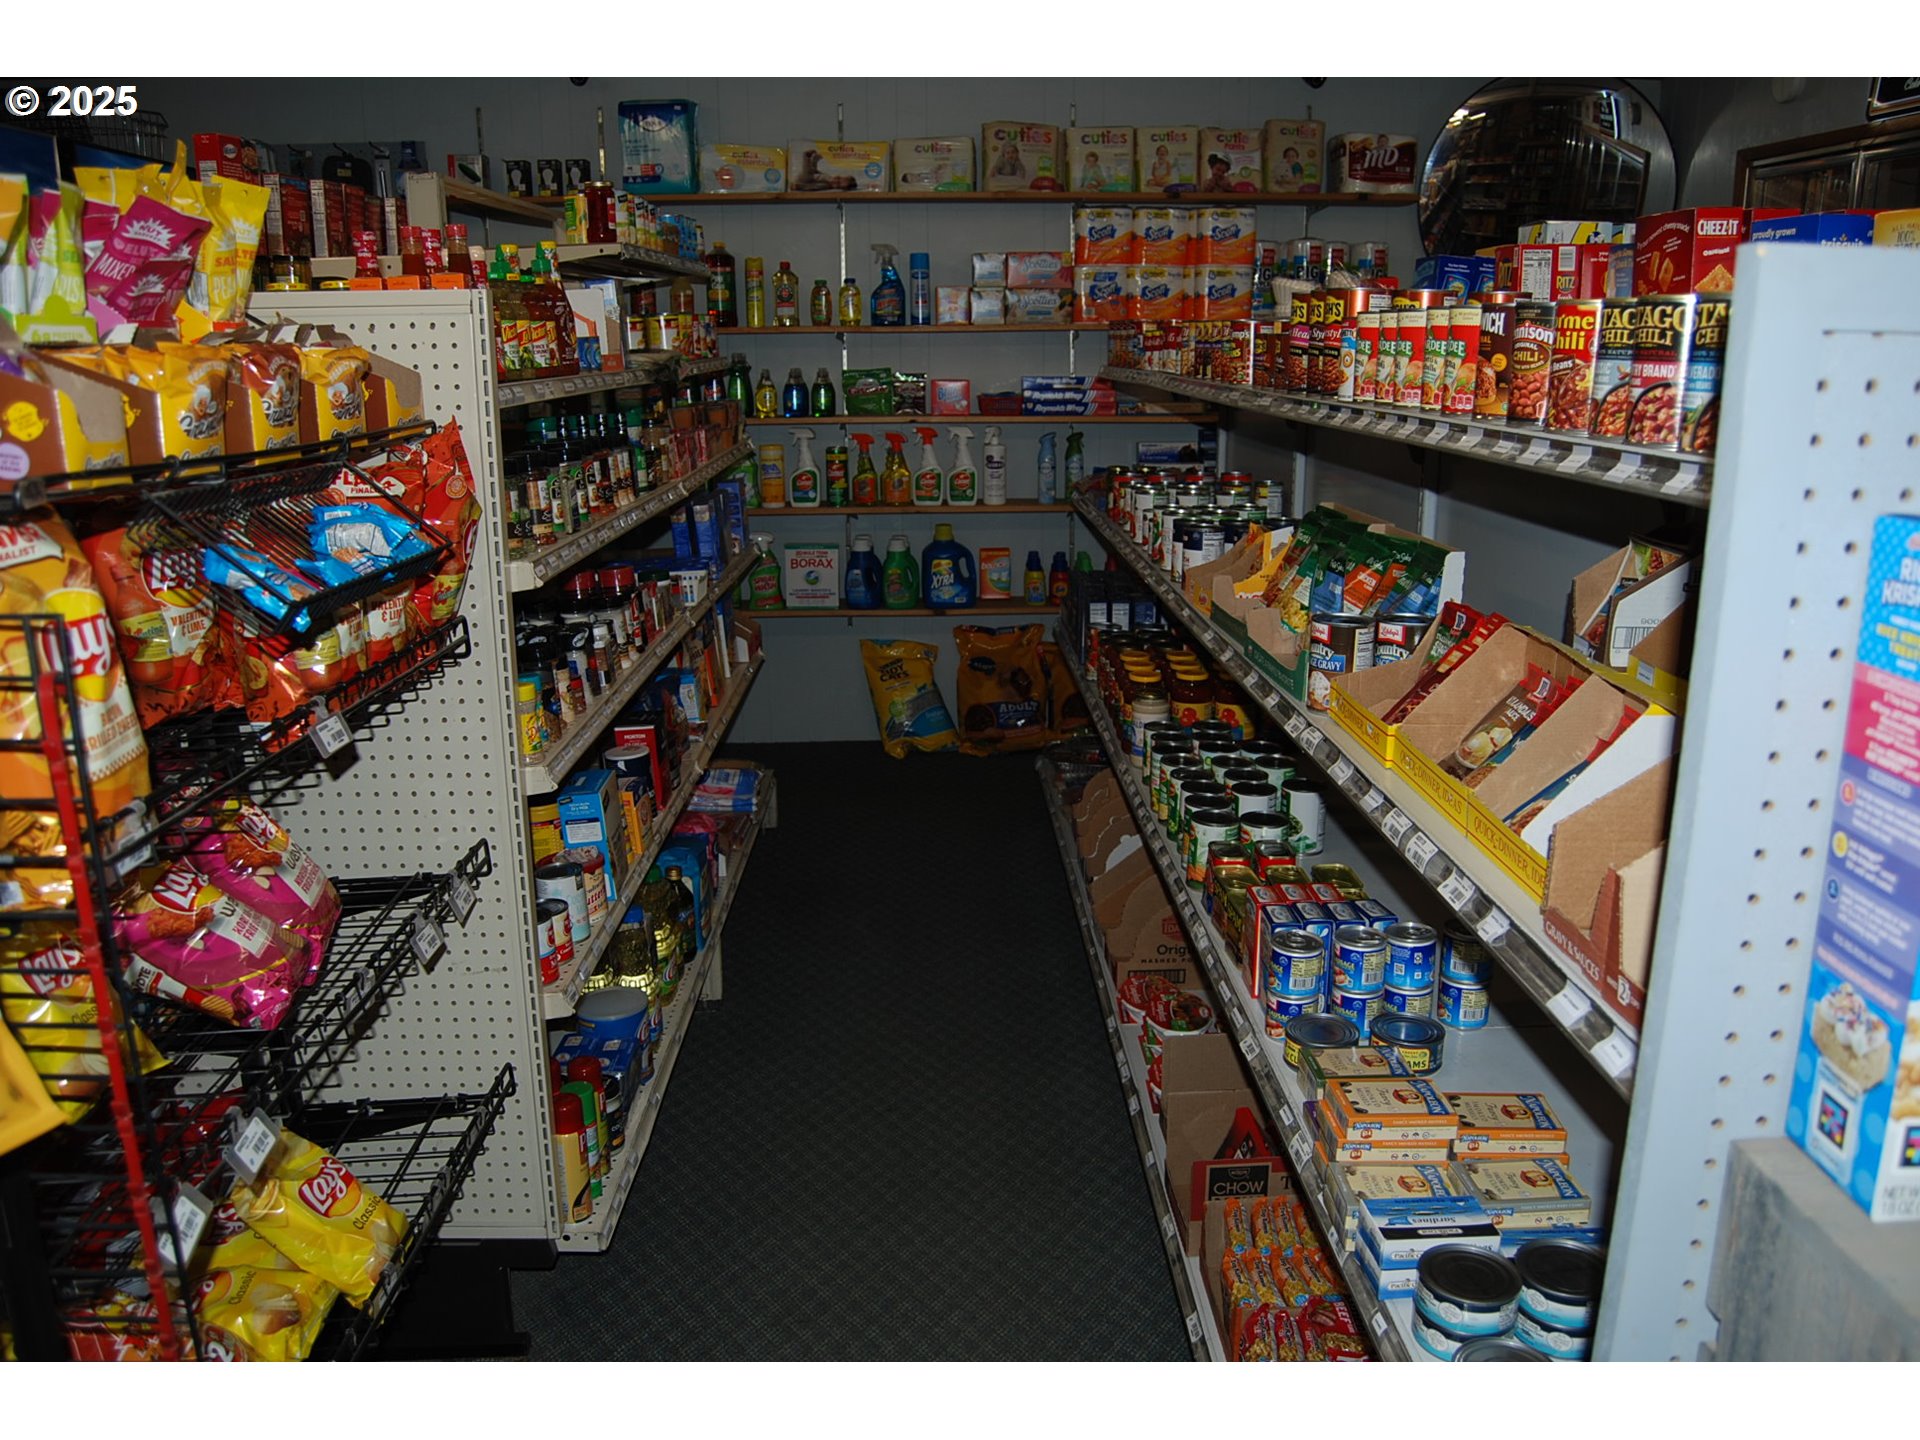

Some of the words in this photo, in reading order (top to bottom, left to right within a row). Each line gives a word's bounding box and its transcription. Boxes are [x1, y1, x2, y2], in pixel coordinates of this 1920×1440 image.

[994, 127, 1053, 143] cuties
[1081, 132, 1127, 144] cuties
[1151, 131, 1187, 143] cuties
[1281, 126, 1318, 138] cuties
[915, 142, 952, 154] cuties
[1697, 219, 1739, 236] CHEEZ-IT
[1556, 275, 1576, 290] RITZ
[1642, 364, 1676, 378] BRAND
[790, 559, 834, 570] BORAX
[932, 573, 955, 589] XTRA
[1317, 658, 1342, 671] GRAVY
[999, 701, 1039, 713] ADULT
[1141, 956, 1179, 965] MASHED
[135, 966, 152, 994] VOTE
[299, 1157, 348, 1216] Lay's
[1213, 1180, 1265, 1195] CHOW
[352, 1194, 383, 1232] Classic
